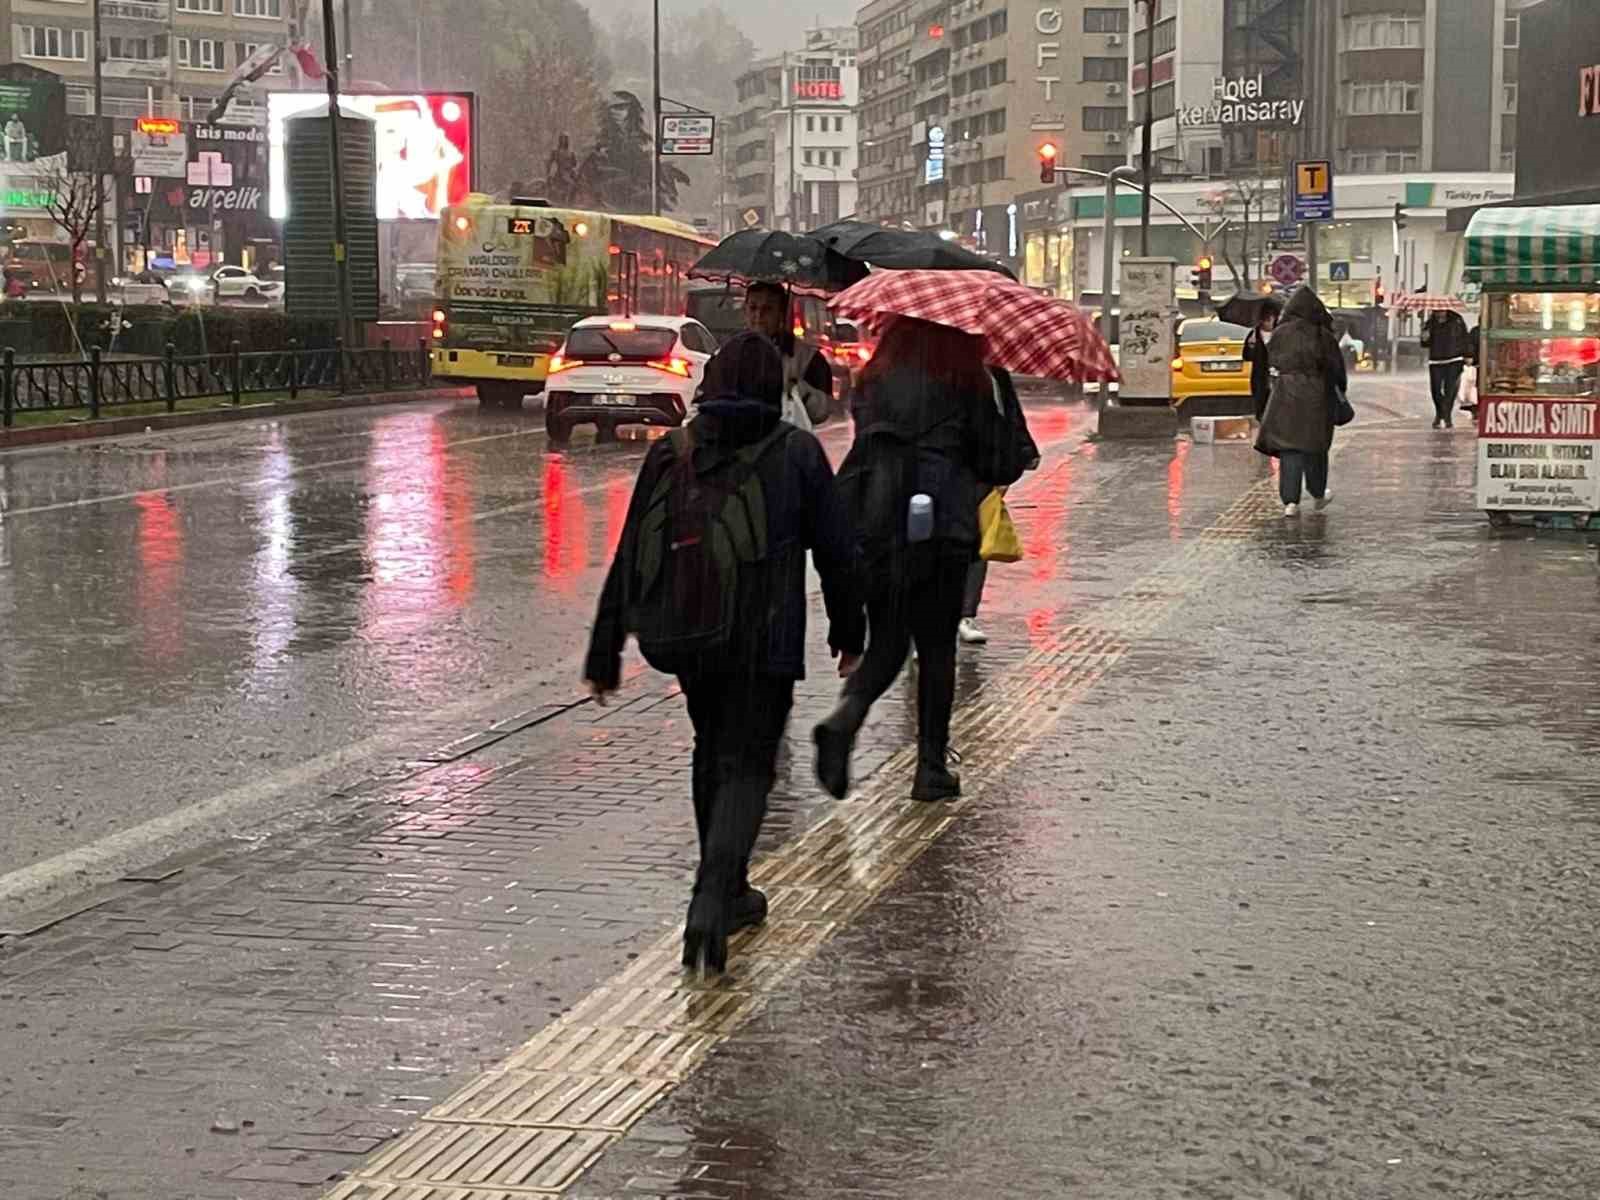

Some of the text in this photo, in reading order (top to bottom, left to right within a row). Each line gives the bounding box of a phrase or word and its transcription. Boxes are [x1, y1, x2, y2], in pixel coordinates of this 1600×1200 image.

[1212, 73, 1262, 100] Hotel
[196, 125, 220, 140] isis
[1304, 167, 1322, 189] T
[1485, 402, 1546, 434] ASKIDA
